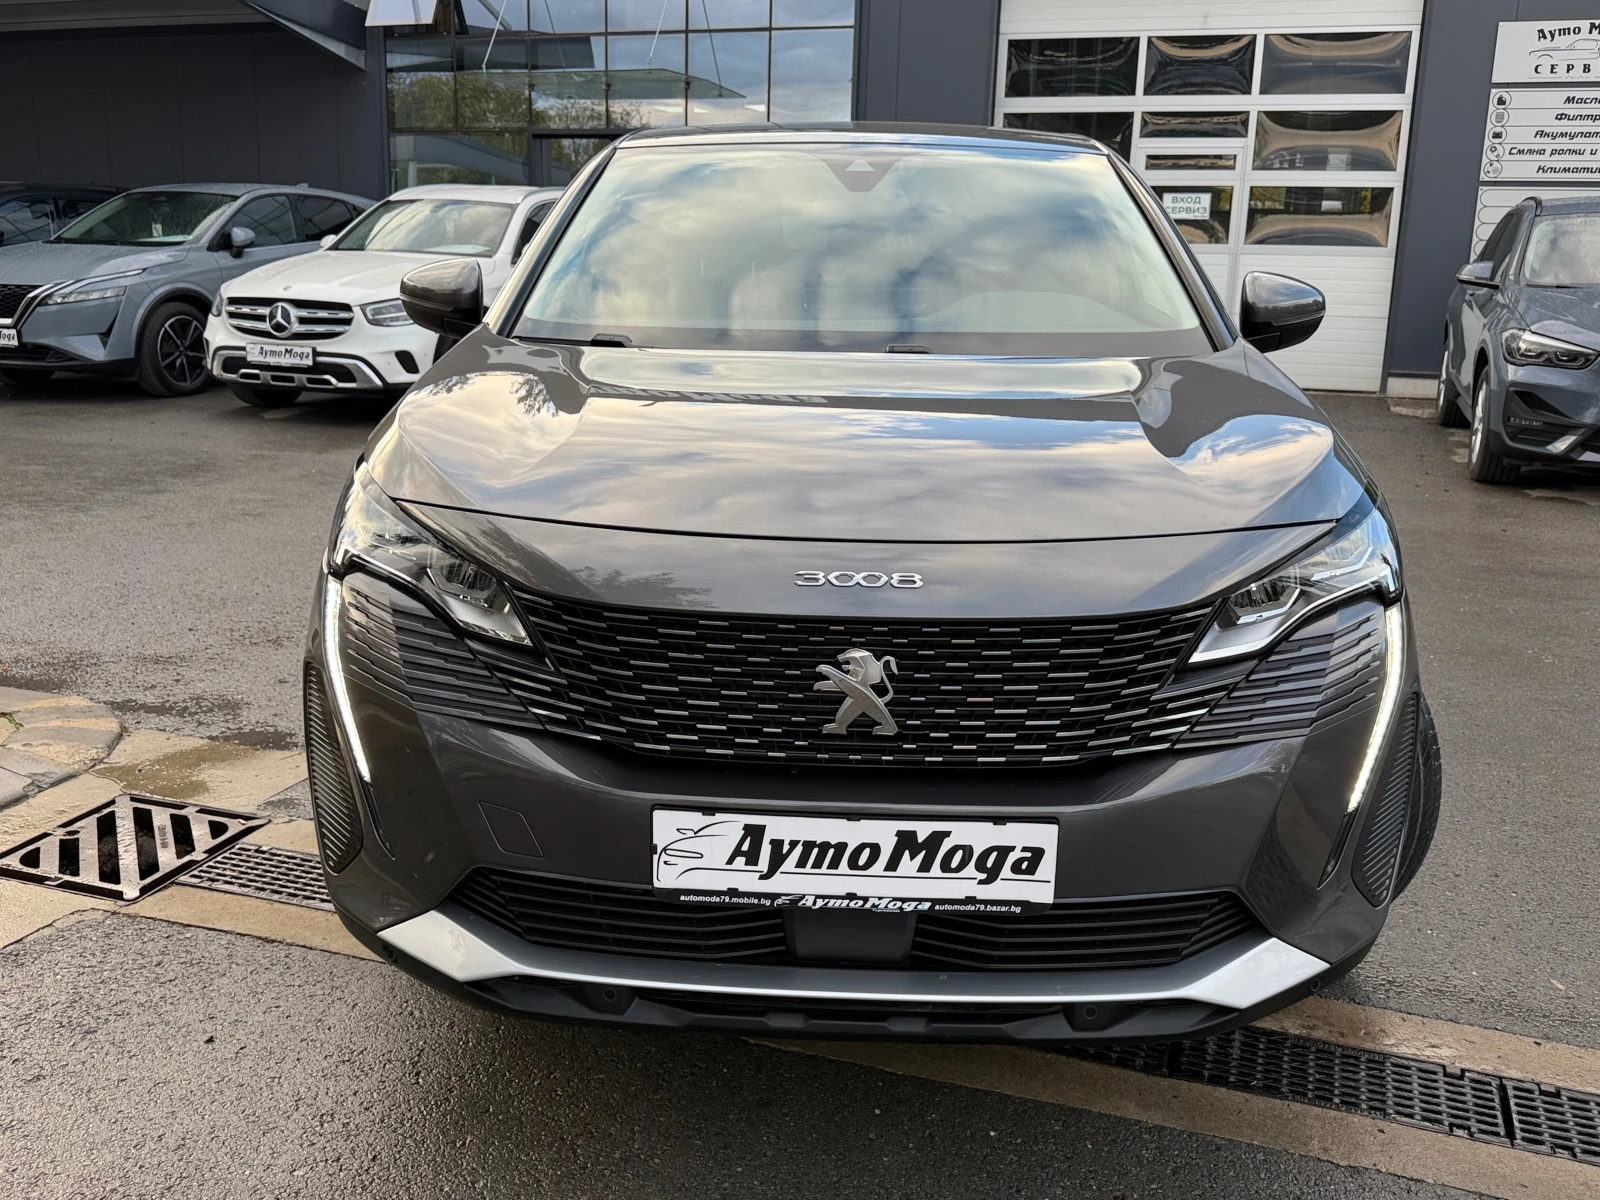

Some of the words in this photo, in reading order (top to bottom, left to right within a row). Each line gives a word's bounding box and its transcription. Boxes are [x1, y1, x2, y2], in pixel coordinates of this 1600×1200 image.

[1534, 63, 1600, 75] СЕРВ
[1563, 95, 1600, 105] Масл
[1589, 148, 1598, 156] и
[1536, 164, 1600, 174] Климати
[1171, 196, 1202, 205] ВХОД
[1164, 206, 1208, 215] СЕРВИЗ
[793, 570, 924, 588] 3008
[679, 894, 772, 906] automoda79.mobile.bg
[934, 903, 1022, 914] automoda79.bazar.bg
